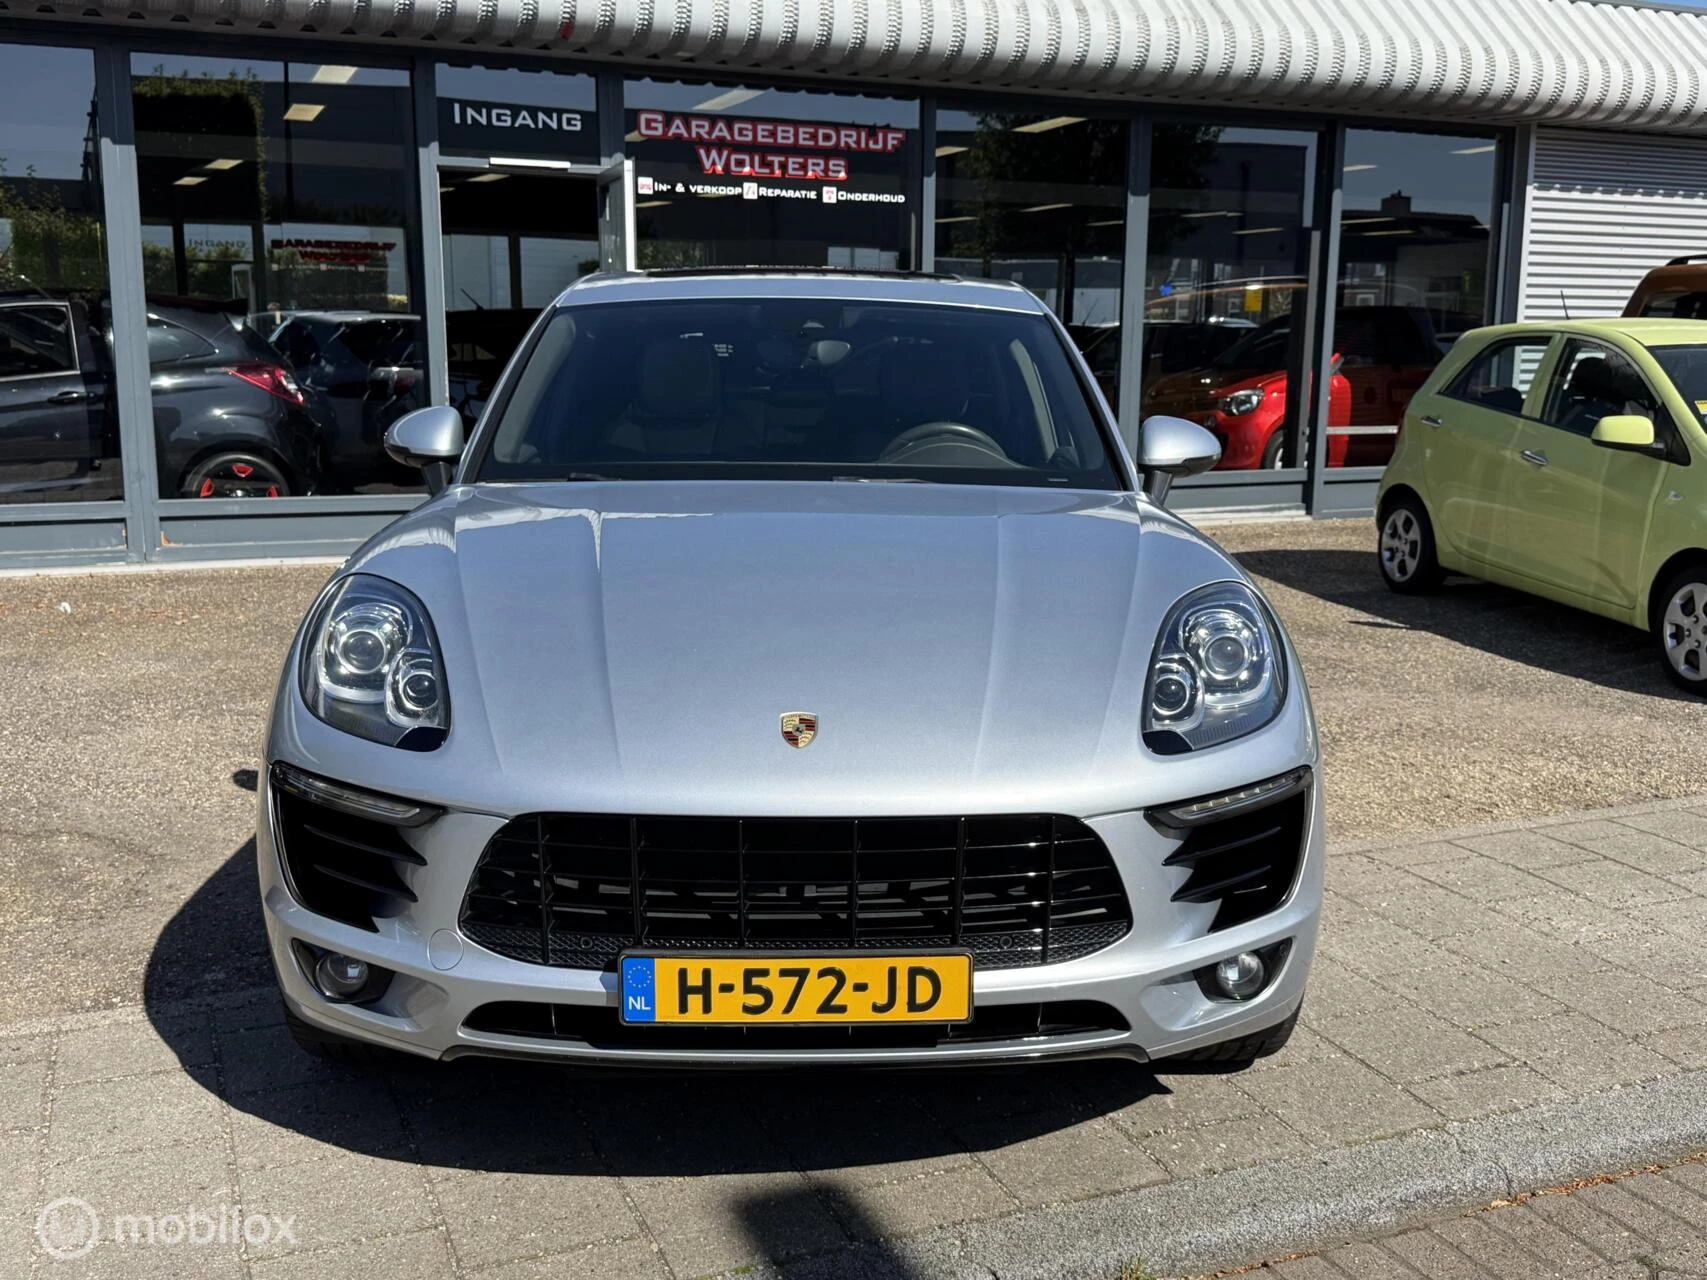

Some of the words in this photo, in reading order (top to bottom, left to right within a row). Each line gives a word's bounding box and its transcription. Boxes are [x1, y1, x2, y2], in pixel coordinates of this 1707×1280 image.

[454, 102, 582, 131] INGANG
[638, 111, 904, 152] GARAGEBEDRIJF
[698, 147, 848, 180] WOLTERS
[675, 182, 686, 193] &
[689, 185, 742, 195] VERKOOP
[759, 187, 817, 199] REPARATIE
[838, 191, 906, 203] ONDERHOUD
[678, 966, 942, 1015] H-572-JD
[628, 996, 651, 1011] NL
